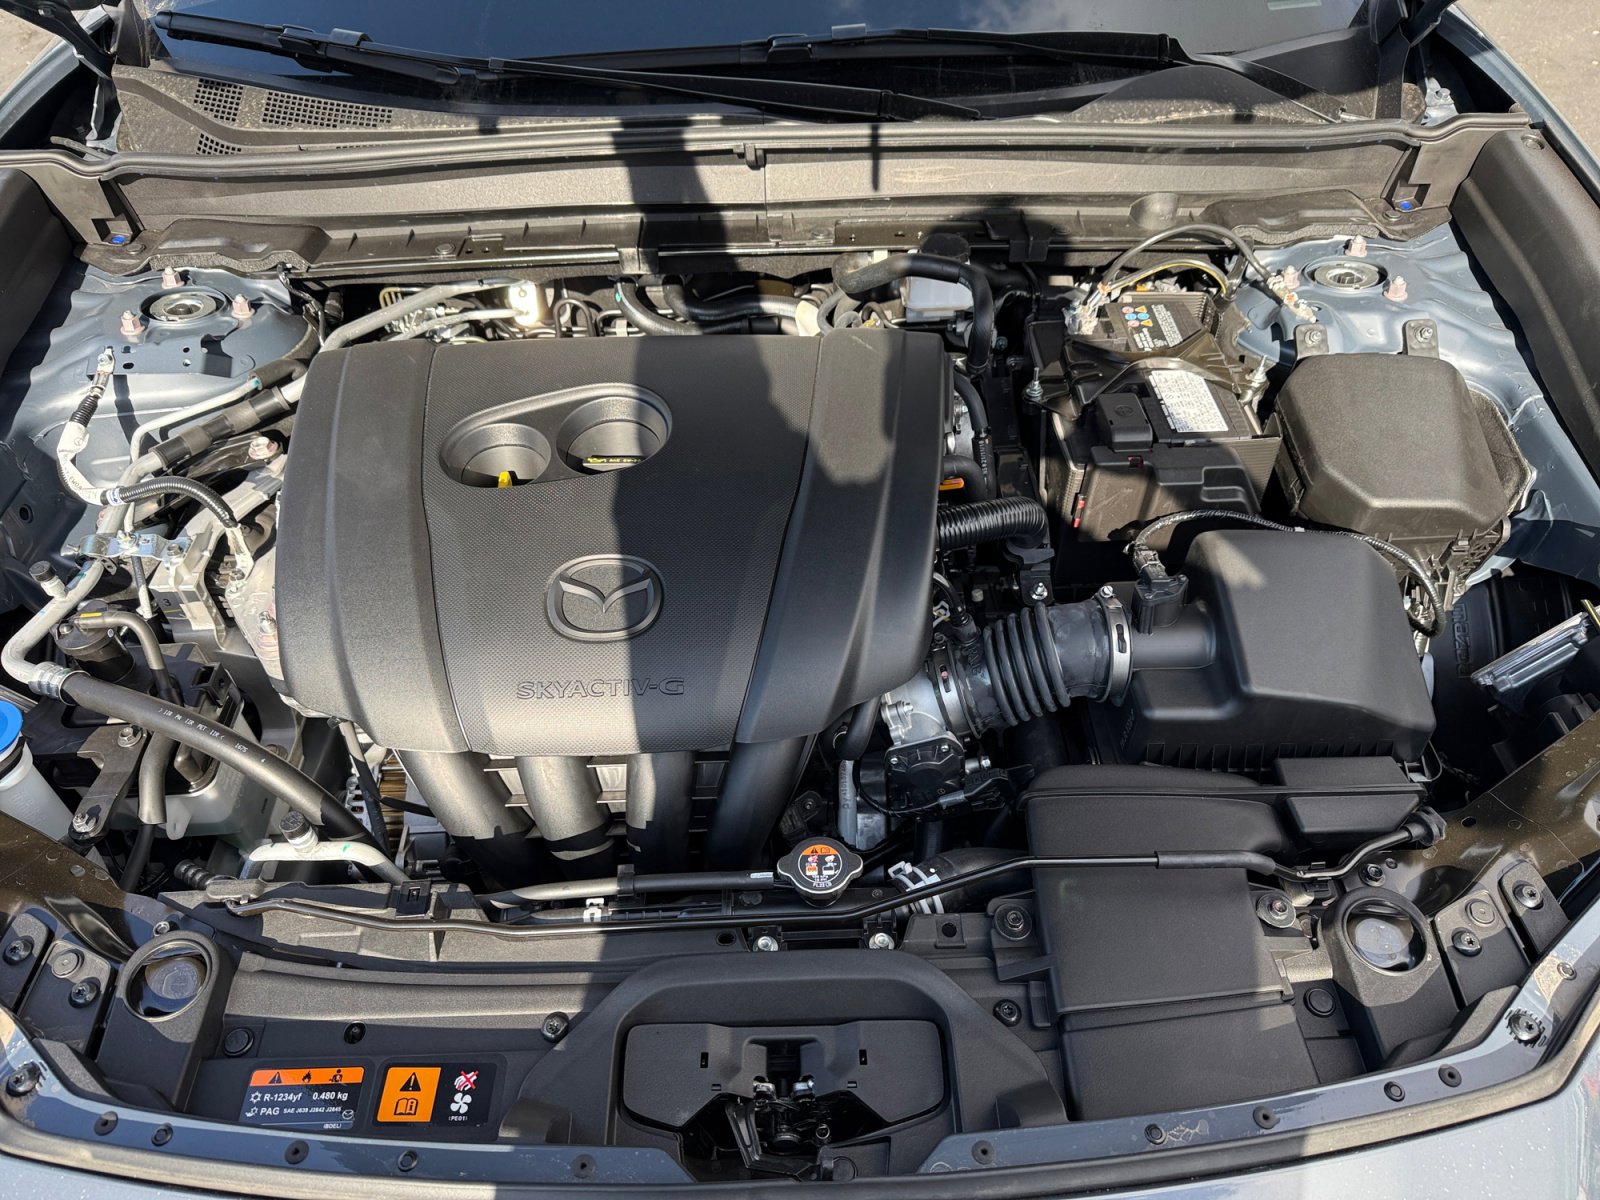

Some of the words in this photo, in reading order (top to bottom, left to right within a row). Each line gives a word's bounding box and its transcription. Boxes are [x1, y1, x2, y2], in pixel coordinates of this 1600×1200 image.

[516, 677, 685, 699] SKYACTIV-G
[263, 1092, 303, 1102] R-1234yf
[312, 1091, 336, 1100] 0.480
[337, 1091, 349, 1101] kg
[260, 1107, 280, 1115] PAG
